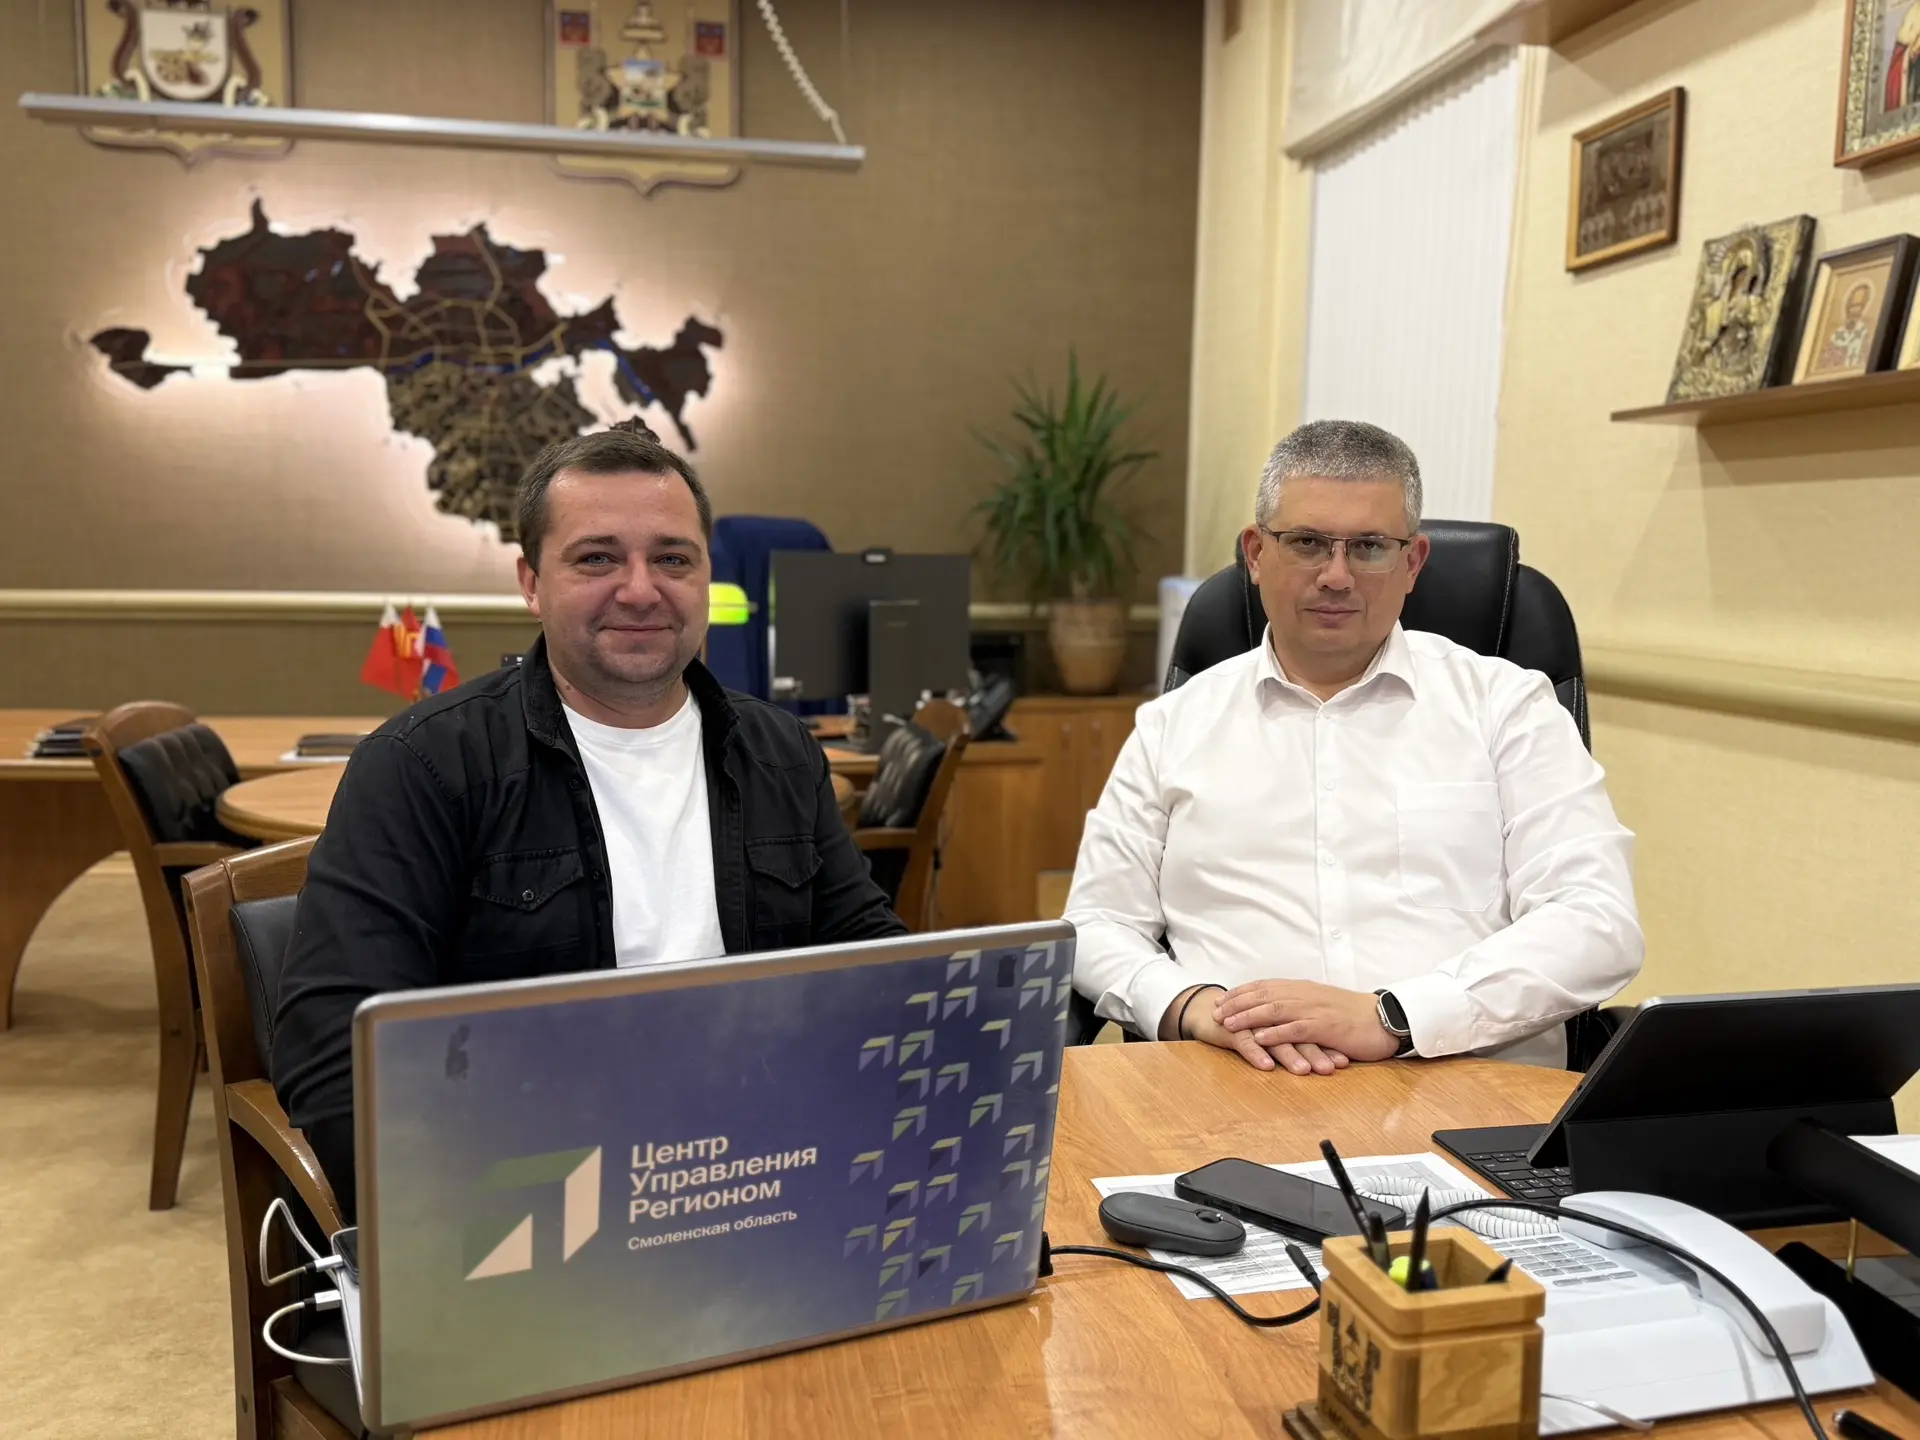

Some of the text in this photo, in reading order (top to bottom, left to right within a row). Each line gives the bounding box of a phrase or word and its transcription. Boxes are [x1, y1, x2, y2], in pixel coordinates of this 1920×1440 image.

[629, 1147, 818, 1196] Управления
[631, 1136, 729, 1169] Центр
[629, 1180, 782, 1224] Регионом
[627, 1210, 798, 1250] Смоленская область
